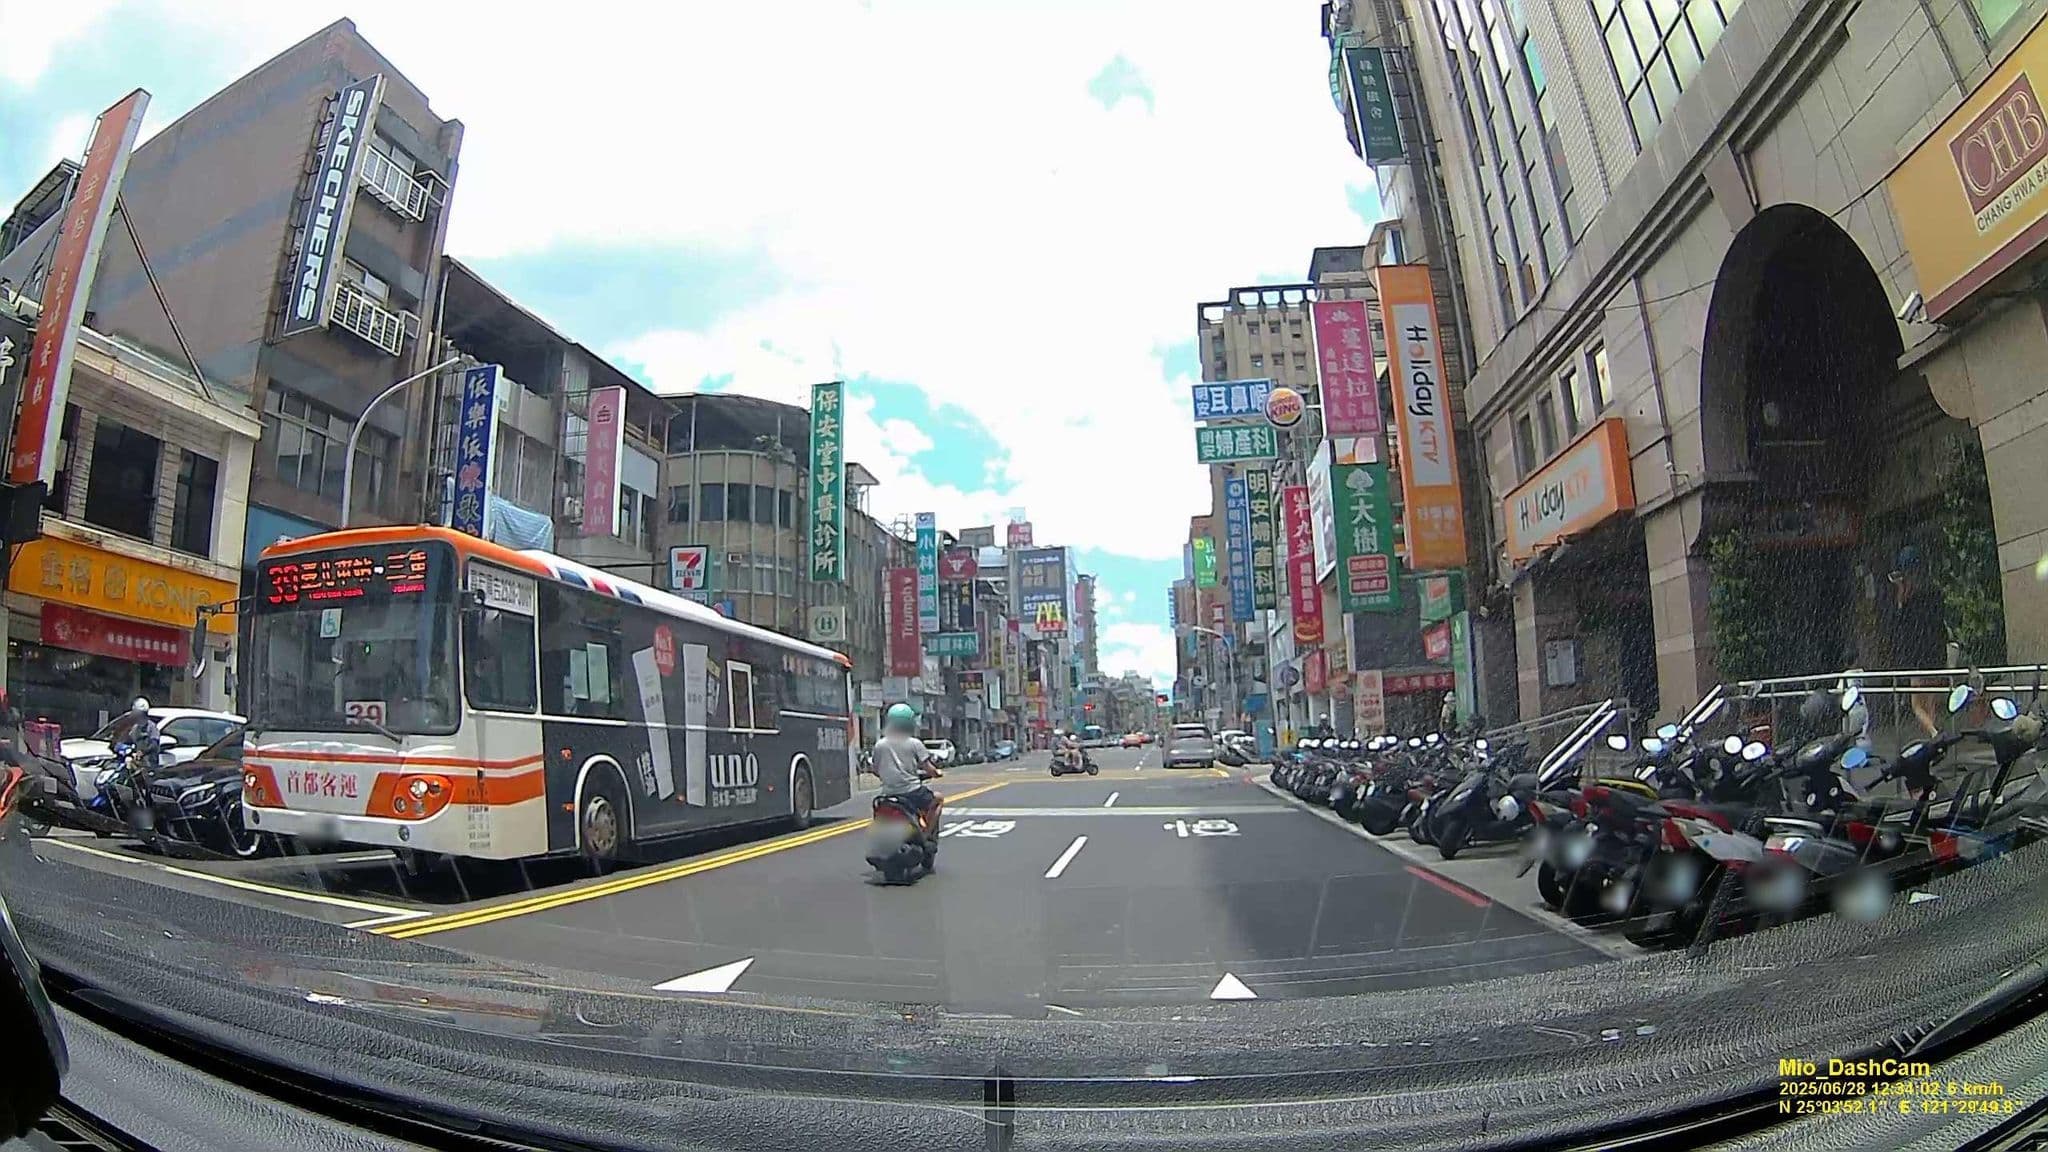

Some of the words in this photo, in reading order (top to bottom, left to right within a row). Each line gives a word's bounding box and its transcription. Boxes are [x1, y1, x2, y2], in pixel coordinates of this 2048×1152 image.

[1961, 90, 2046, 197] CHB
[296, 89, 366, 321] SKECHERS
[1976, 196, 2013, 232] CHANG
[2012, 176, 2037, 204] HWA
[1405, 325, 1434, 416] Holiday
[1215, 427, 1271, 456] 婦產科
[1418, 420, 1439, 466] KTV
[813, 389, 839, 576] 保安堂中醫診所
[1520, 480, 1565, 532] Holiday
[1350, 497, 1379, 553] 大樹
[902, 585, 915, 638] Triumph
[287, 771, 358, 798] 首都客運
[710, 753, 758, 787] uno
